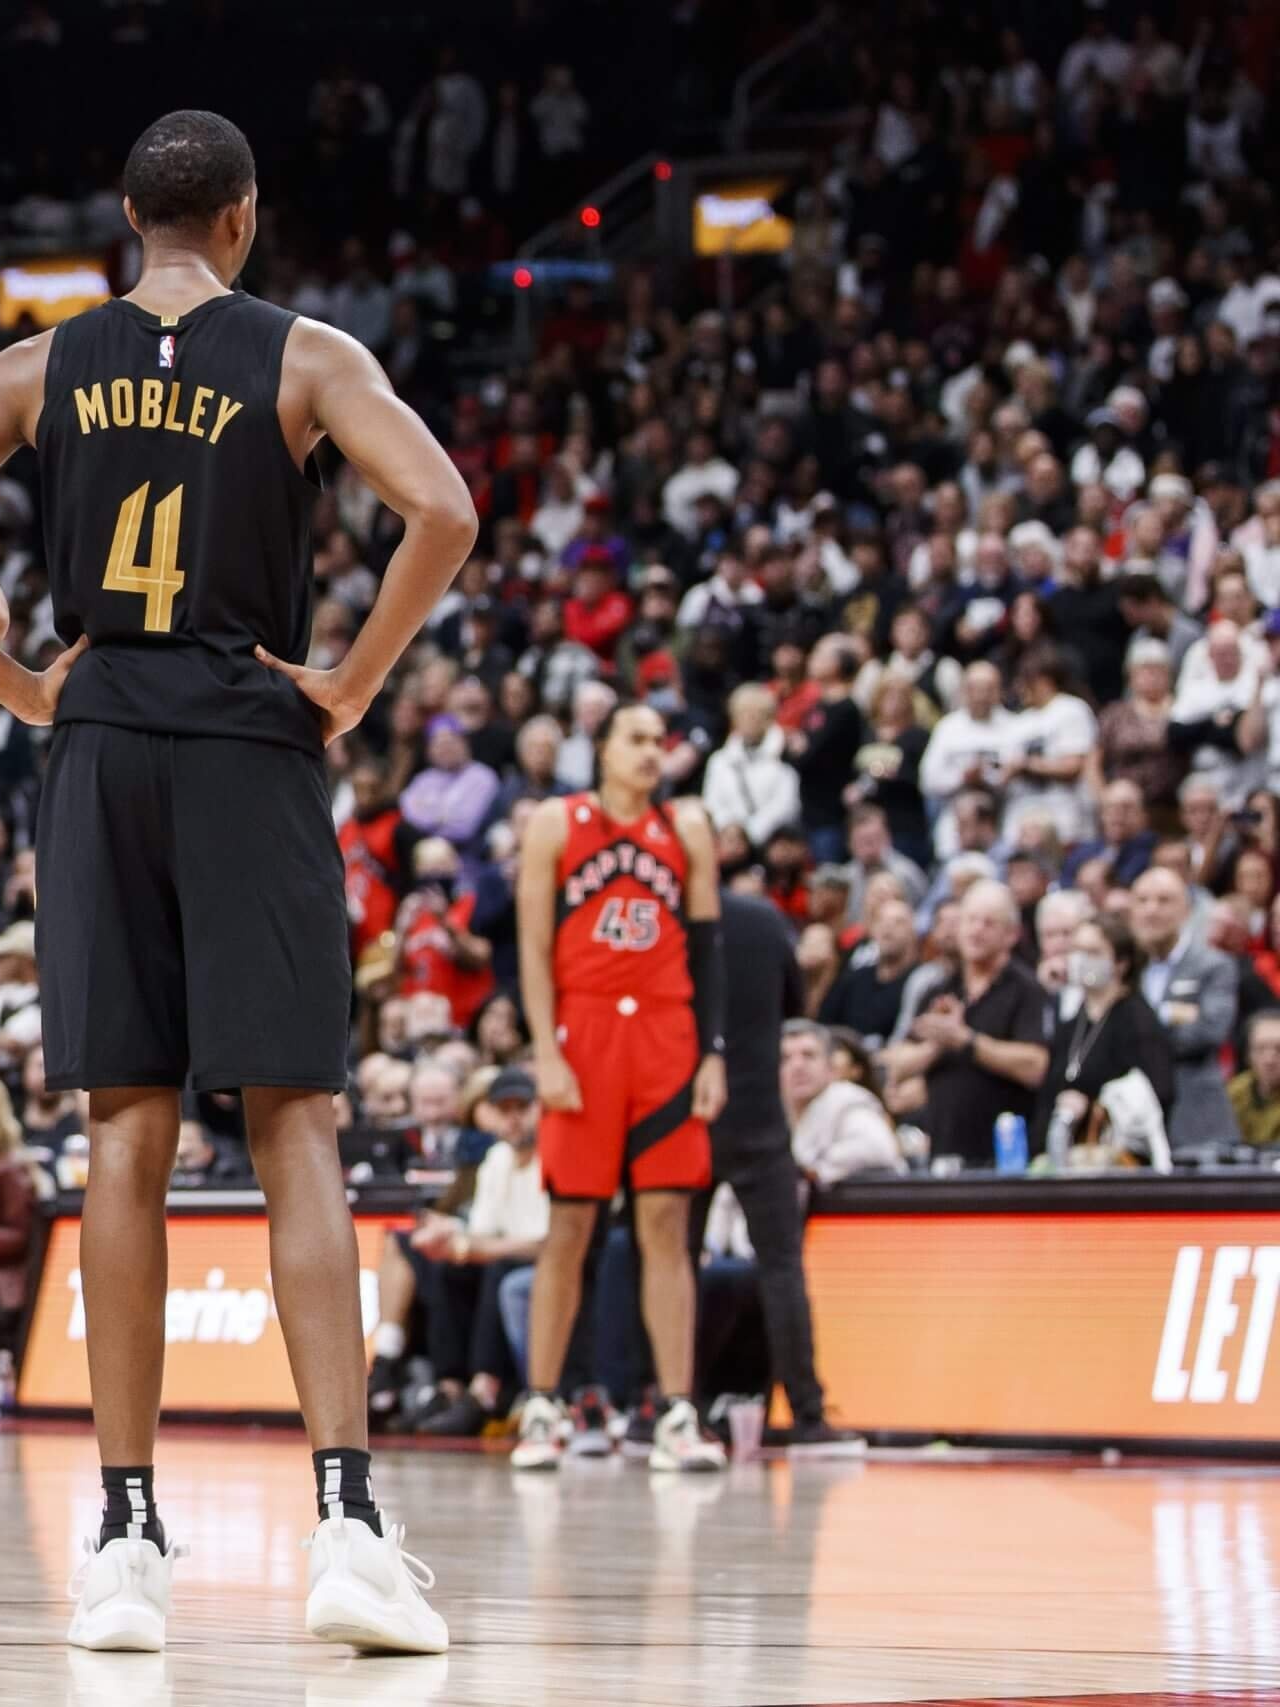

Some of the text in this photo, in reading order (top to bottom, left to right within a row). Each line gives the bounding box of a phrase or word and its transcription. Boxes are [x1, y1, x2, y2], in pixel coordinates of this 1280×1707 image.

[73, 377, 244, 445] MOBLEY
[102, 480, 185, 633] 4
[592, 897, 661, 952] 45
[1151, 1245, 1280, 1404] LET
